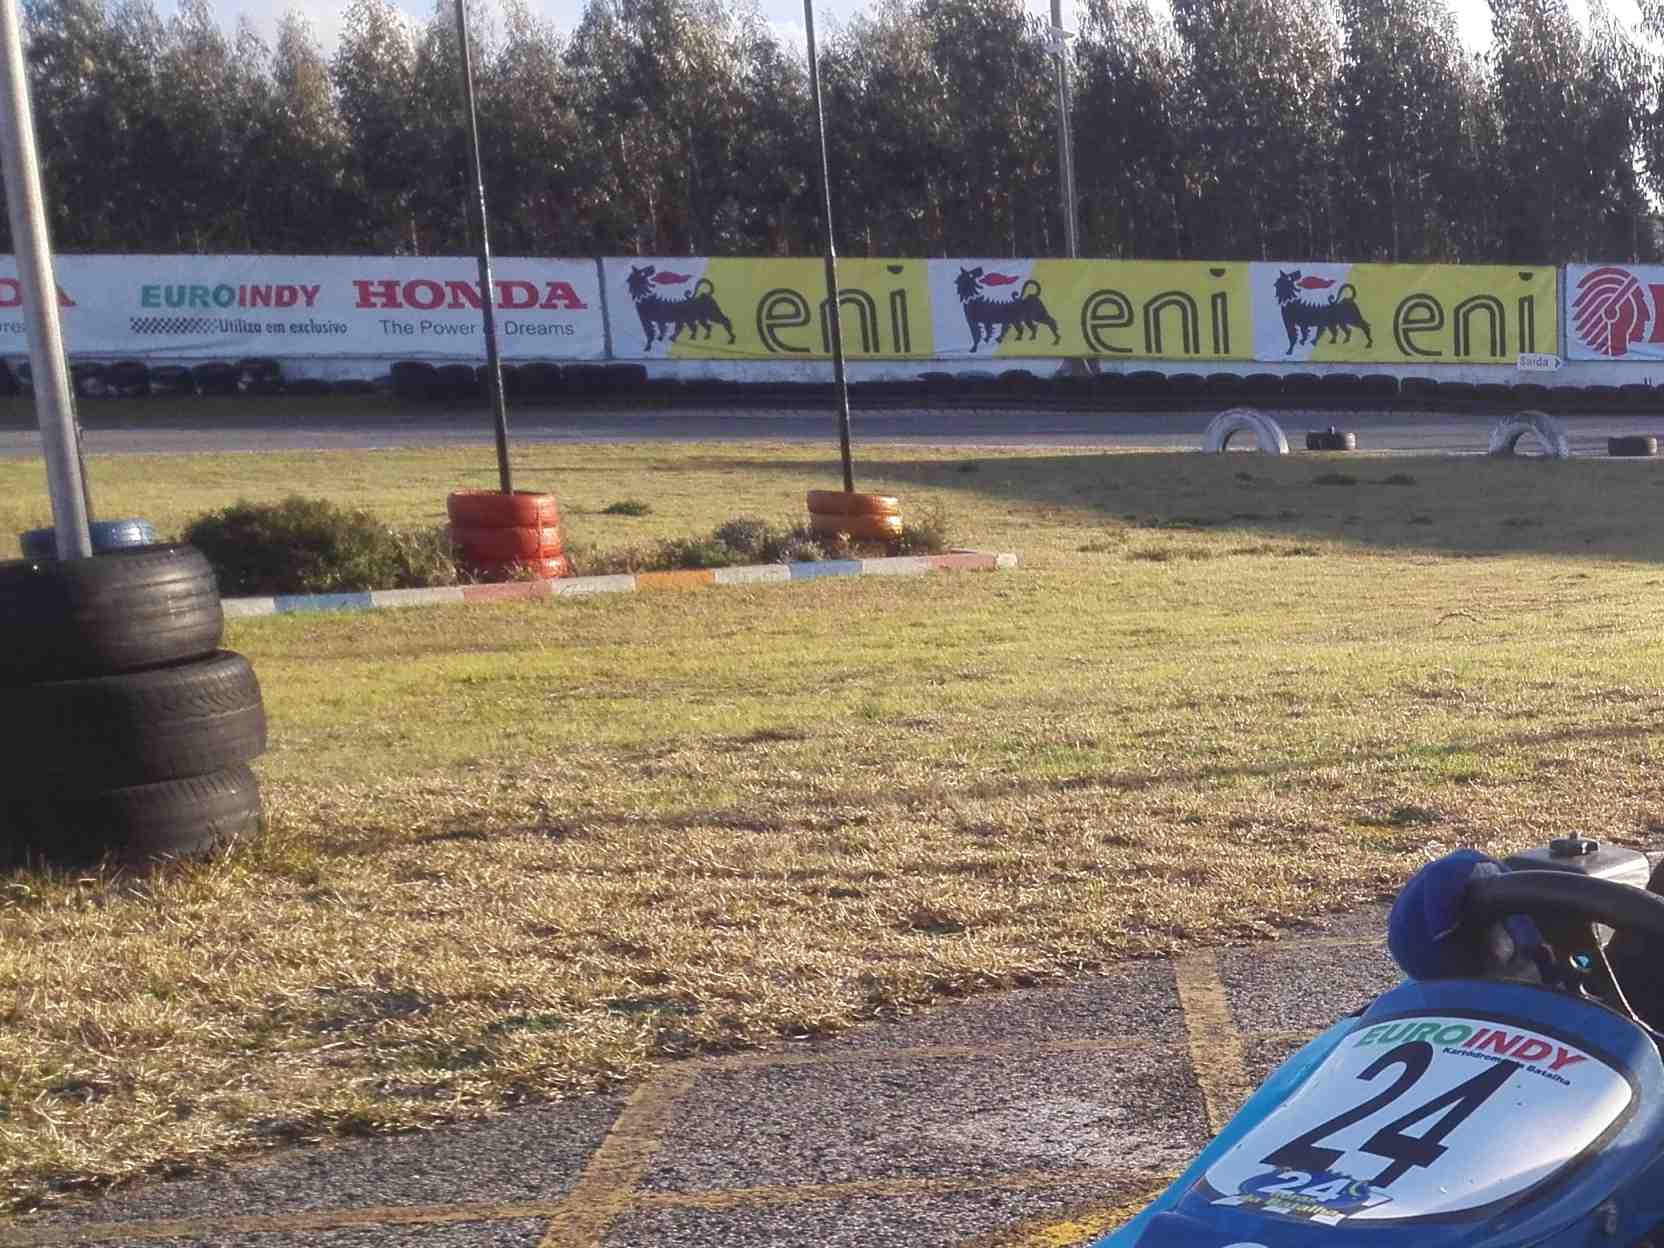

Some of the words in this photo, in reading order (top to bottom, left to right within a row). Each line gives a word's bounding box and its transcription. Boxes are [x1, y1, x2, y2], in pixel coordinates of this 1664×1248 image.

[141, 284, 320, 308] EUROINDY
[353, 279, 588, 310] HONDA
[756, 264, 911, 354] eni
[1081, 267, 1231, 355] eni
[1393, 271, 1535, 358] eni
[265, 322, 286, 334] em
[289, 318, 348, 334] exclusivo
[379, 319, 414, 335] The
[420, 319, 475, 335] Power
[504, 319, 575, 336] Dreams
[1359, 1021, 1588, 1071] EUROINDY
[1442, 1046, 1503, 1063] Kartódrom
[1526, 1064, 1571, 1086] Batalha
[1258, 1040, 1524, 1189] 24
[1255, 1170, 1351, 1202] 24
